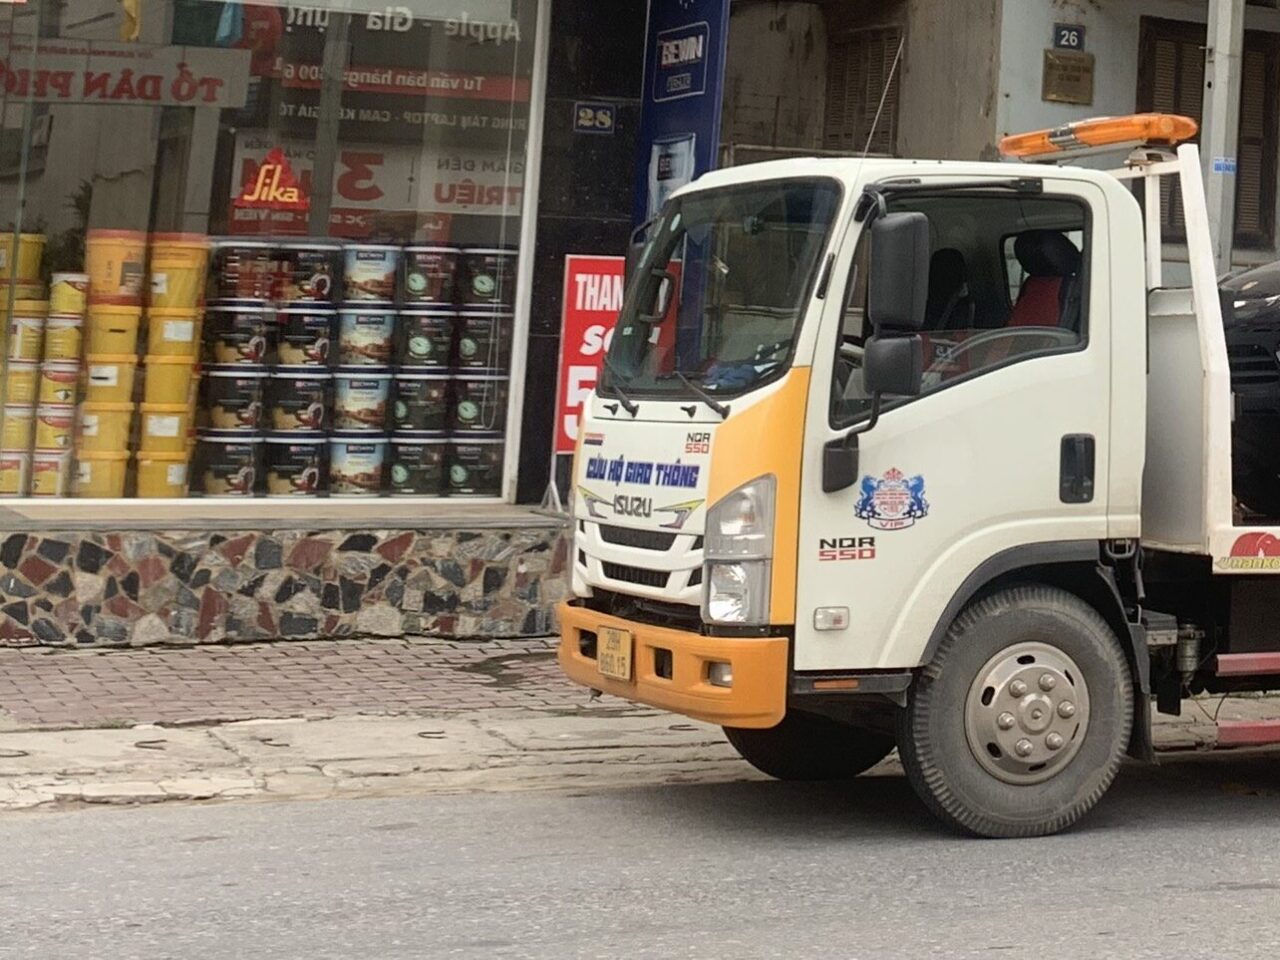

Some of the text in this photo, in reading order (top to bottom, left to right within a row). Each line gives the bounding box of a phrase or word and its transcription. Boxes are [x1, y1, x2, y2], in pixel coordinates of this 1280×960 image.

[1060, 30, 1078, 46] 26
[578, 107, 611, 128] 28
[243, 164, 299, 203] Sika
[686, 432, 711, 443] NQR
[685, 443, 710, 454] 550
[624, 461, 654, 485] GIAO
[655, 458, 700, 488] THÔNG
[613, 494, 652, 518] ISUZU
[819, 536, 875, 549] NQR
[819, 549, 876, 561] 550
